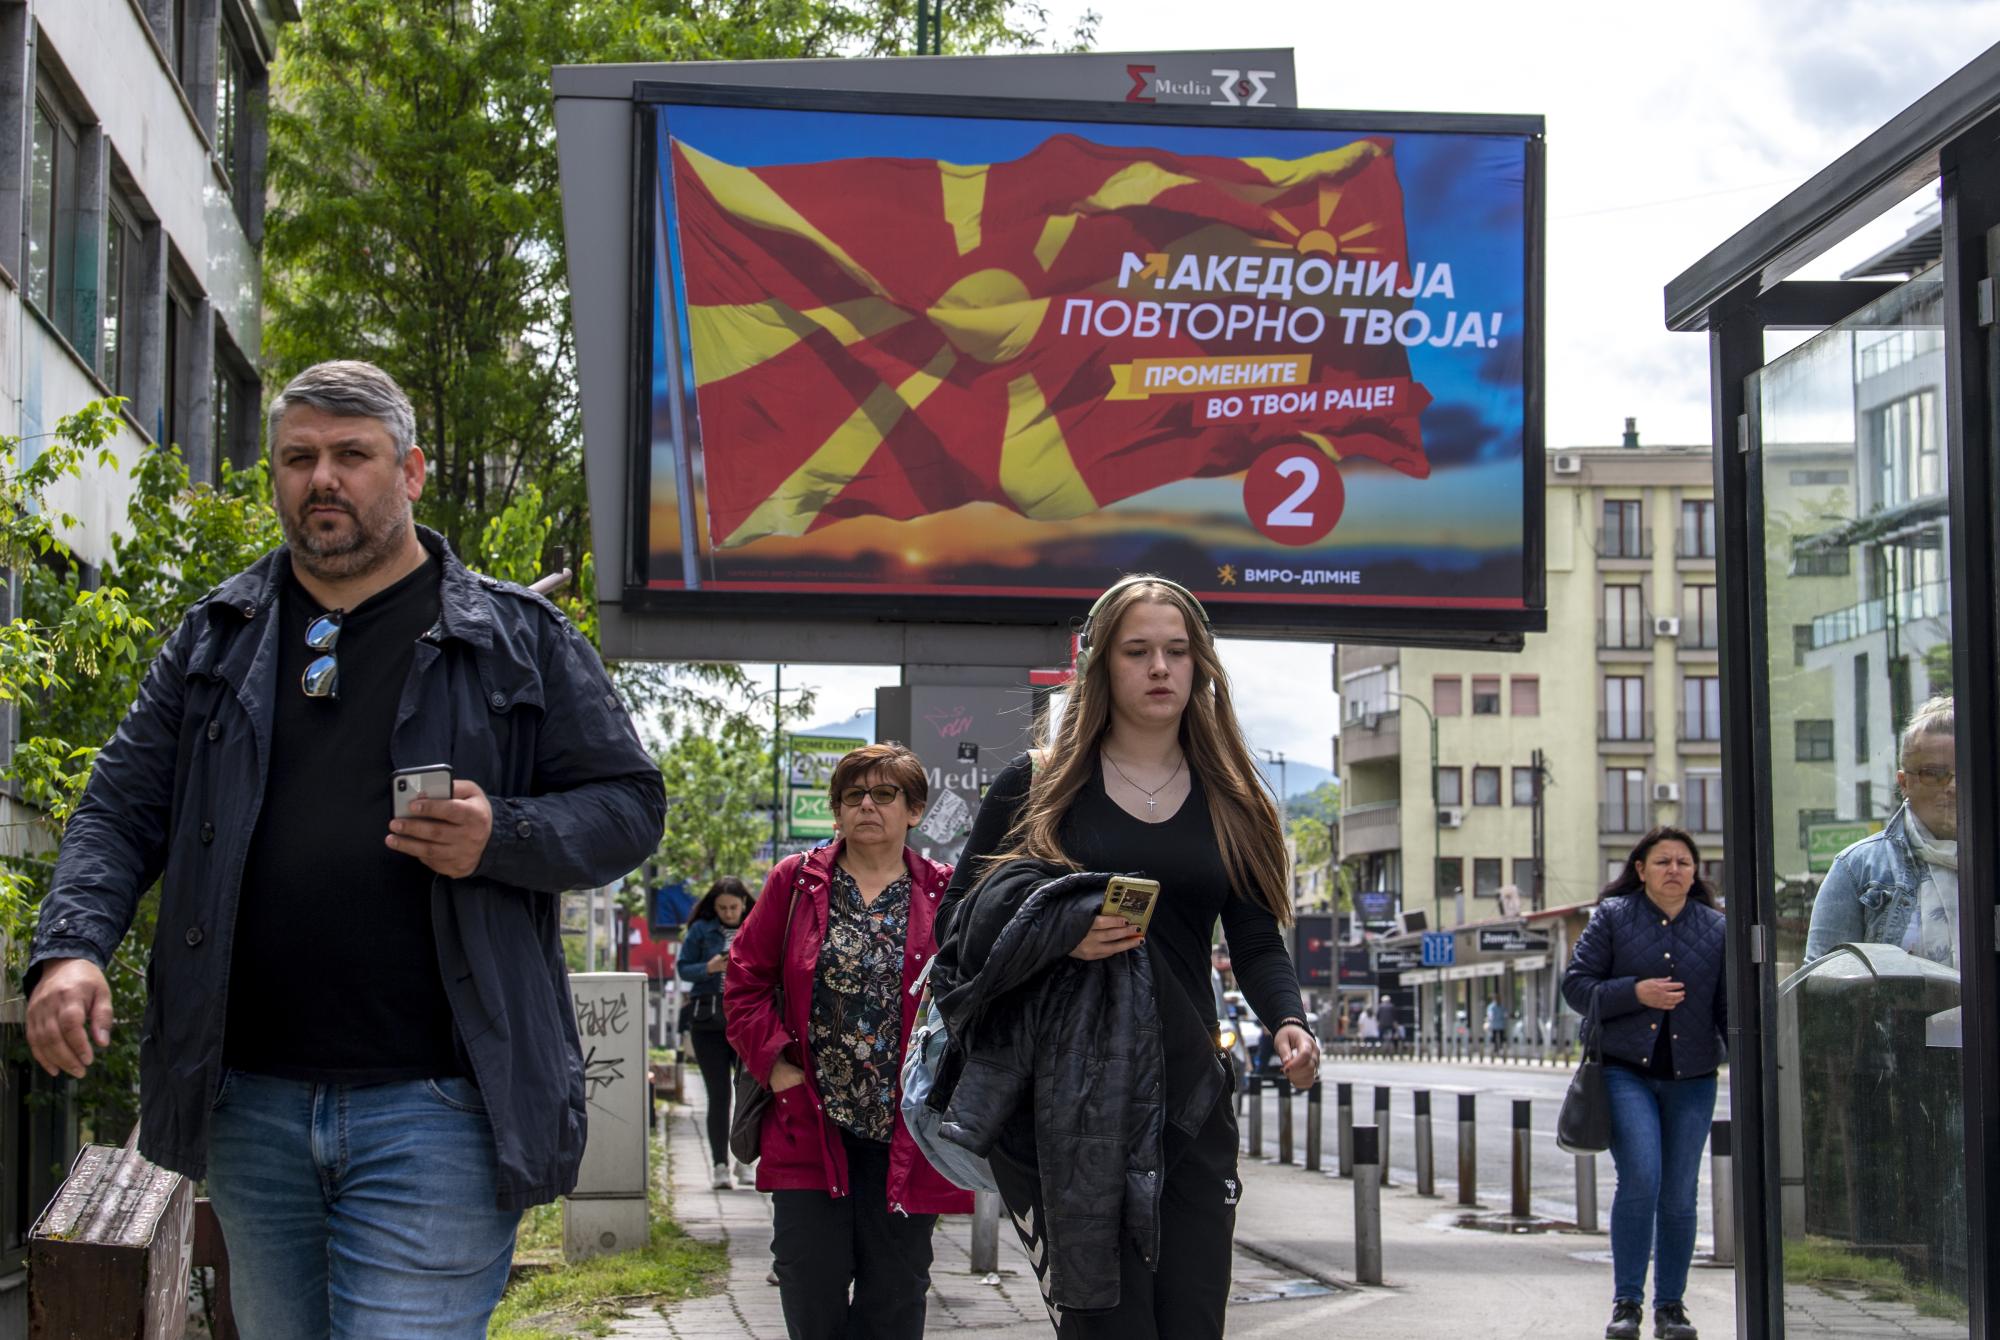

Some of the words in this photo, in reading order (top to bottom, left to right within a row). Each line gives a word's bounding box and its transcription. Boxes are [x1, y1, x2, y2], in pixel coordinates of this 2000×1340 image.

[1155, 79, 1211, 95] Media
[1117, 252, 1455, 300] МАКЕДОНИЈА
[1060, 299, 1325, 343] ПОВТОРНО
[1339, 307, 1503, 348] ТВОЈА!
[1144, 362, 1298, 387] ПРОМЕНИТЕ
[1206, 396, 1243, 419] ВО
[1250, 391, 1317, 416] ТВОИ
[1324, 385, 1395, 411] РАЦЕ!
[1266, 456, 1320, 527] 2
[1244, 568, 1361, 584] ВМРО-ДПМНЕ
[922, 767, 994, 790] Medi
